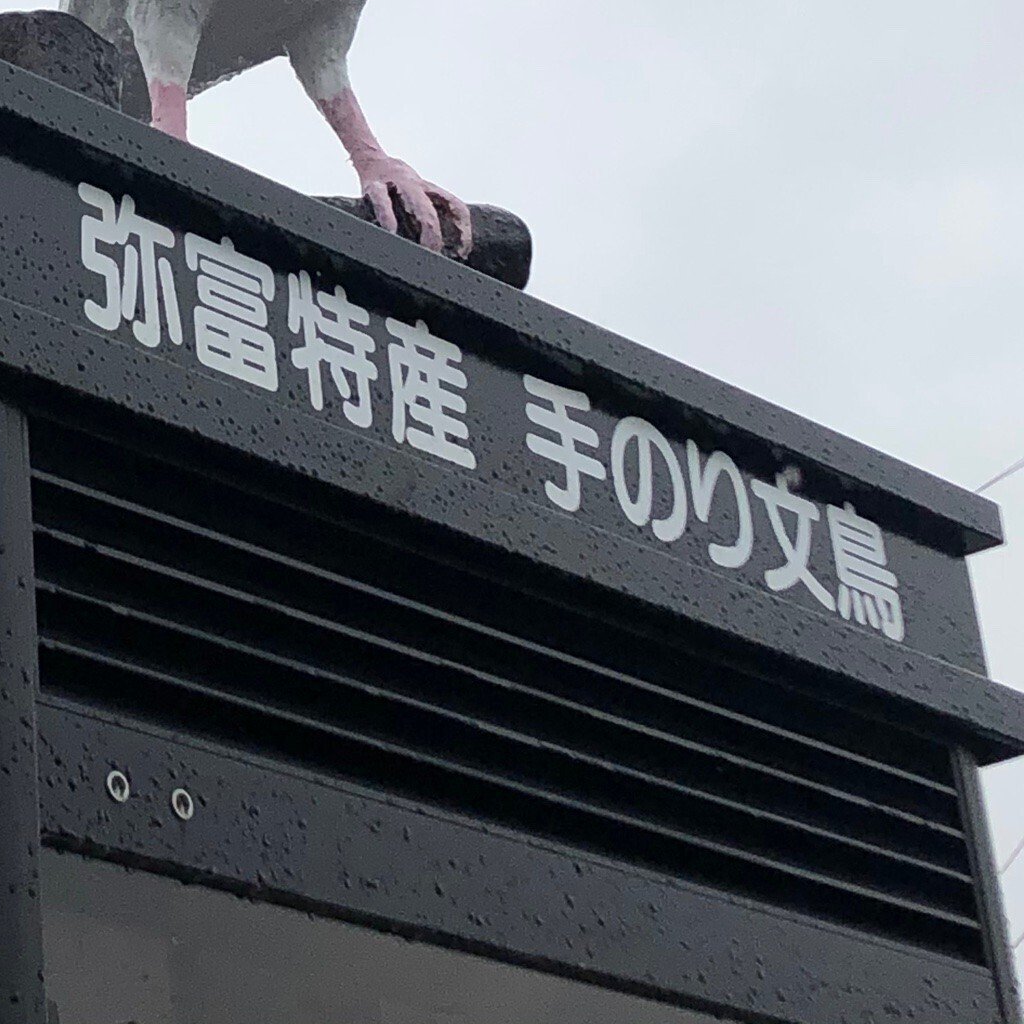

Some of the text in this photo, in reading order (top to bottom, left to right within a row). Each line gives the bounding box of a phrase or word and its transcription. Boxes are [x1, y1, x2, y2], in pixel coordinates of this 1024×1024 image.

[78, 183, 905, 642] 弥富特産 手のり文鳥
